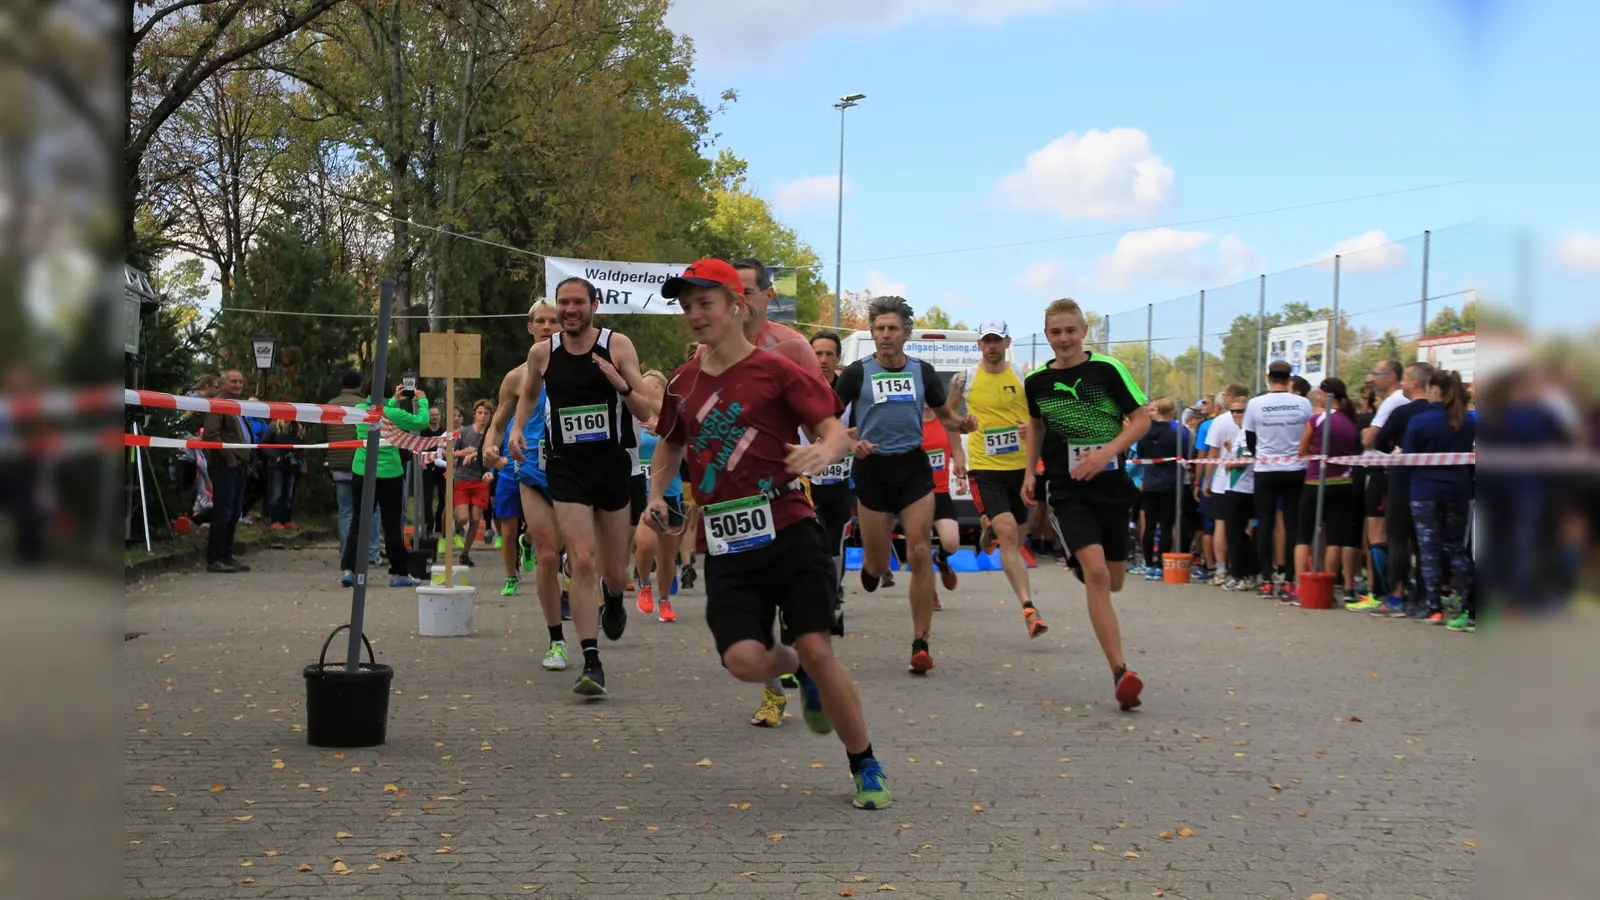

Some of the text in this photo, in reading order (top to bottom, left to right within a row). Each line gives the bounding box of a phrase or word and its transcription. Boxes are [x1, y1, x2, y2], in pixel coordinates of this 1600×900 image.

[585, 267, 680, 285] Waldperlach
[595, 287, 632, 306] ART
[876, 379, 912, 393] 1154
[563, 413, 605, 432] 5160
[710, 401, 744, 442] YOUR
[986, 431, 1018, 447] 5175
[709, 508, 767, 539] 5050
